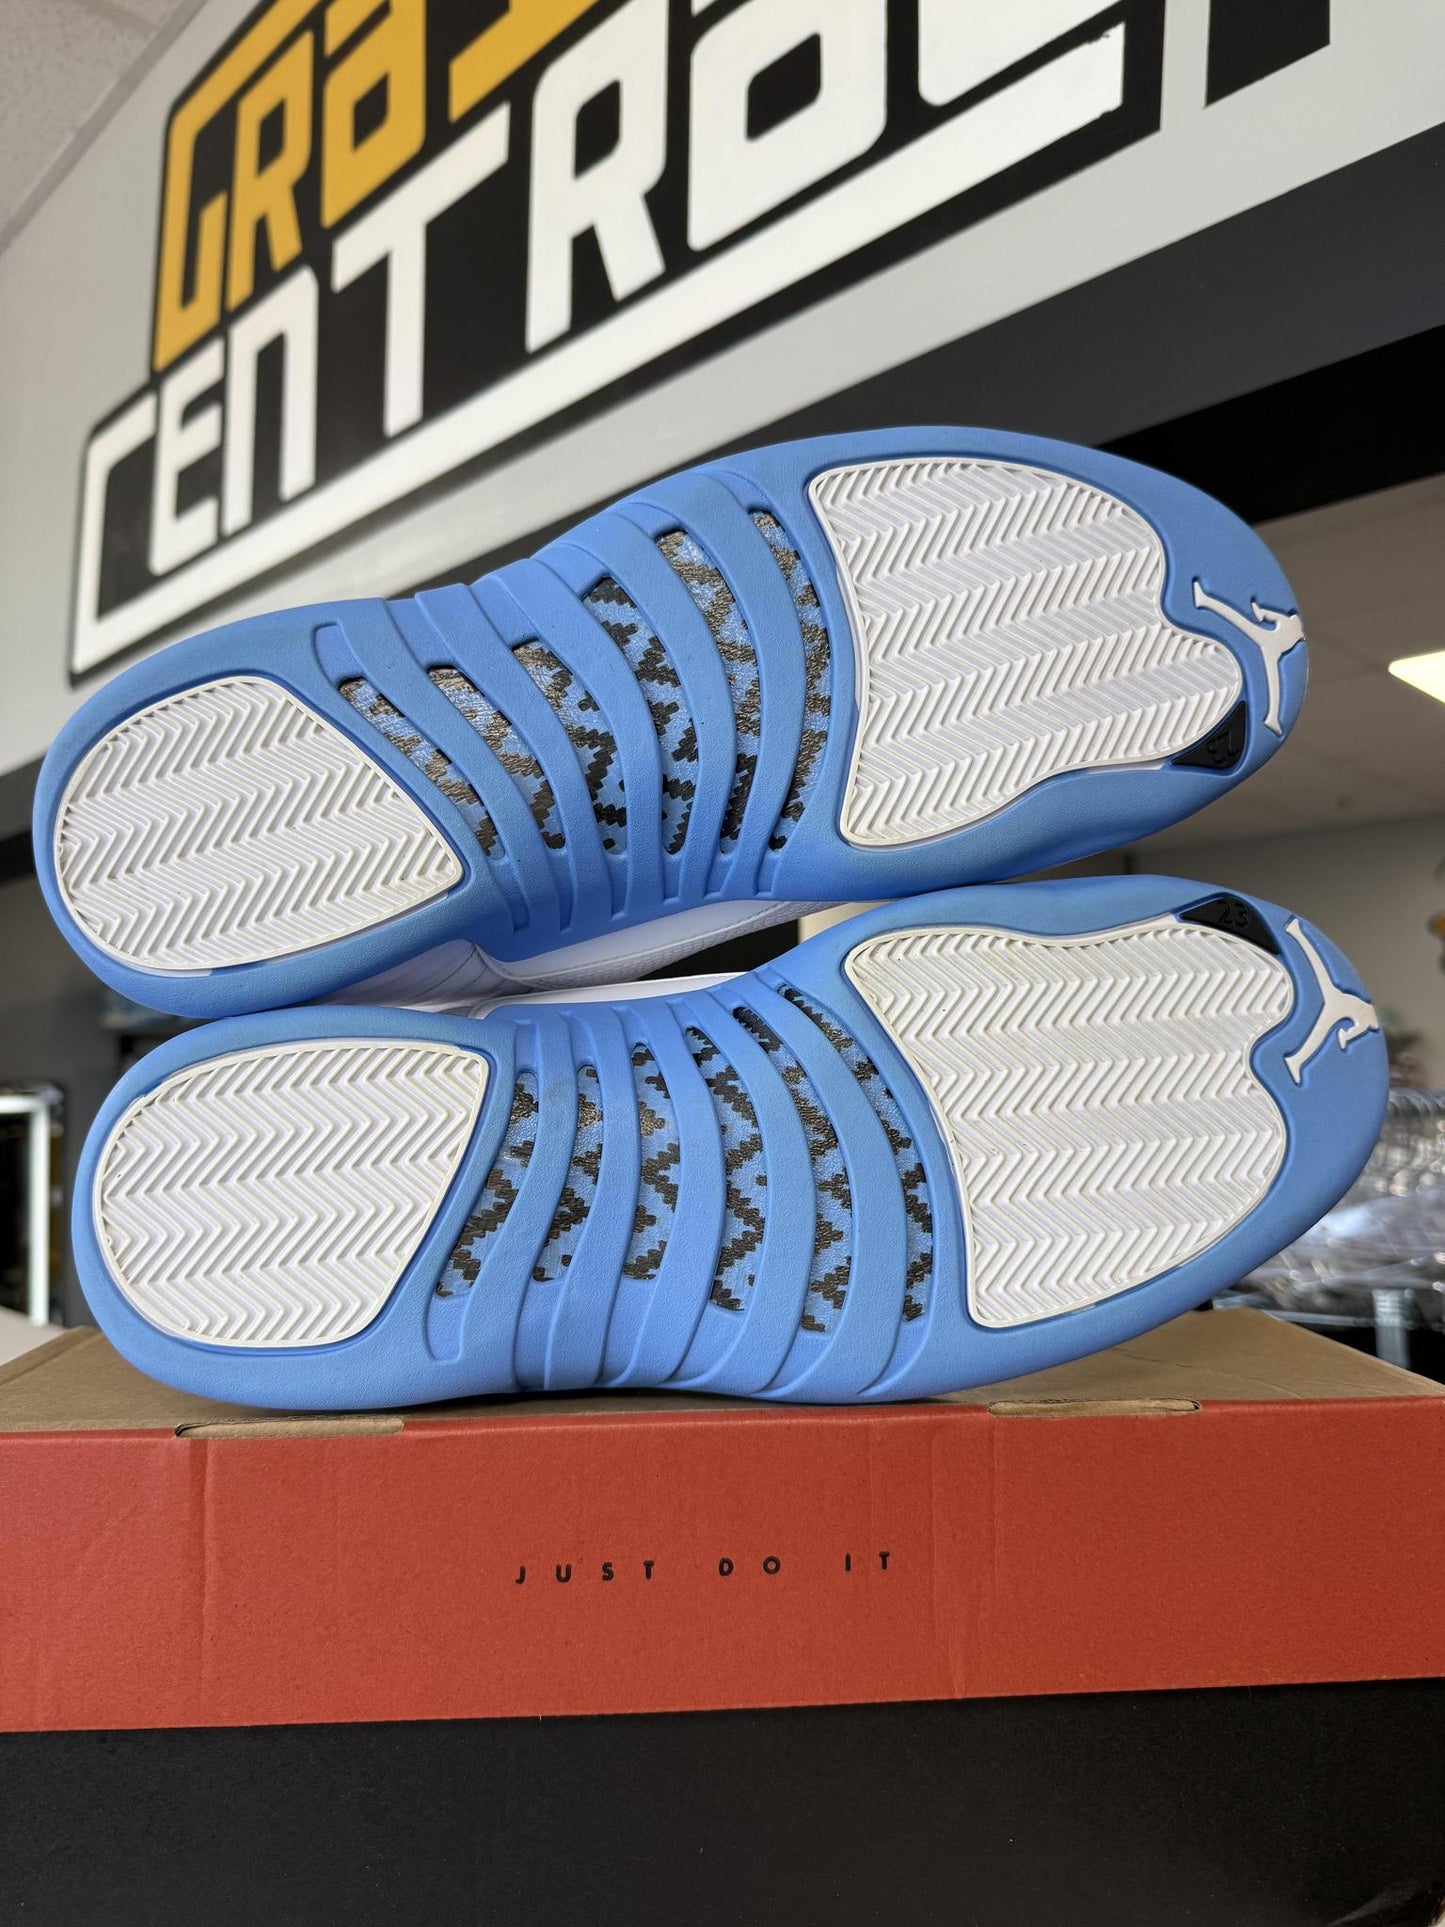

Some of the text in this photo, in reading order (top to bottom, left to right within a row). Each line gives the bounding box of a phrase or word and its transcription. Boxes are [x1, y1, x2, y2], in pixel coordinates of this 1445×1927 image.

[1217, 899, 1249, 928] 23
[515, 1550, 891, 1585] JUST DO IT
